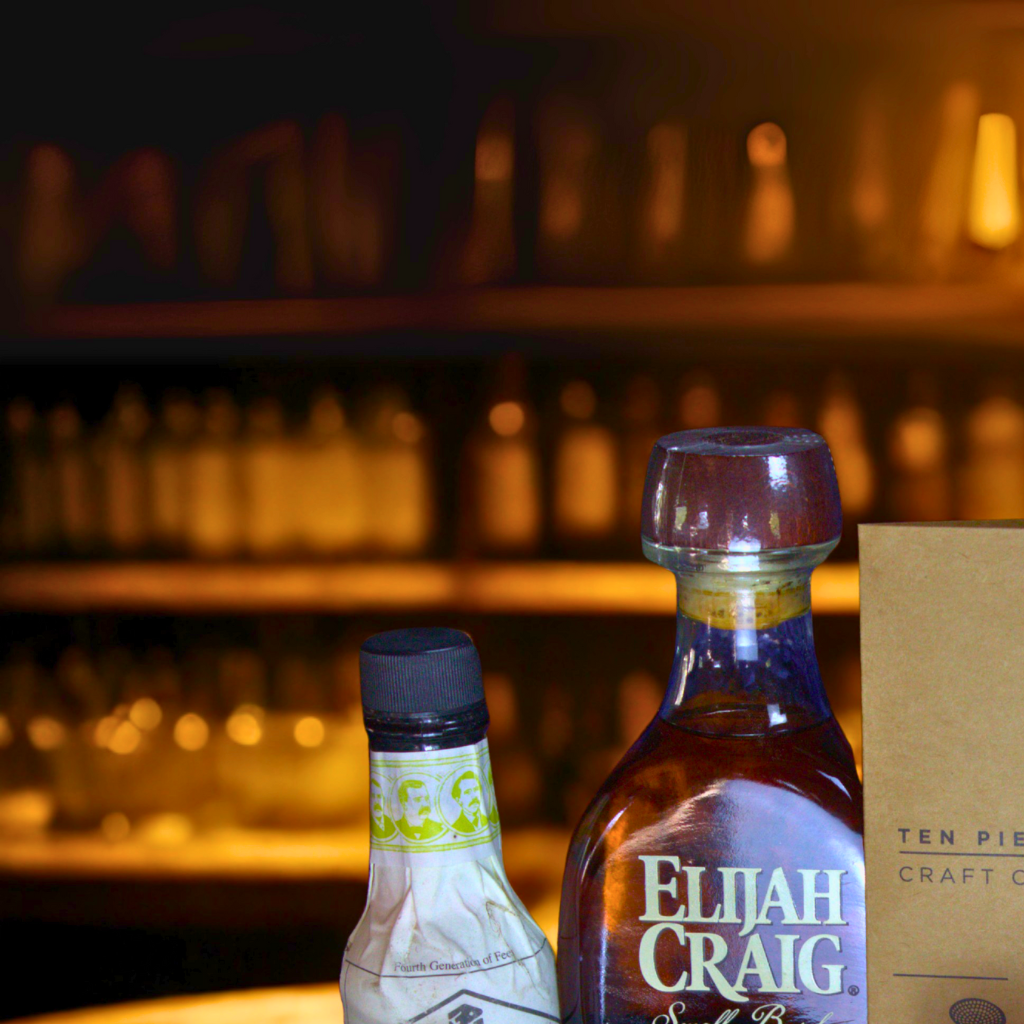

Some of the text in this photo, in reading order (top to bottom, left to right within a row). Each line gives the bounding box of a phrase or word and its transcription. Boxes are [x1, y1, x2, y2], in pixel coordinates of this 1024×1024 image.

[898, 828, 955, 846] TEN
[899, 866, 994, 885] CRAFT
[637, 854, 848, 937] ELIJAH
[393, 961, 427, 973] Fourth
[429, 958, 481, 971] Generation
[482, 955, 494, 965] of
[637, 922, 847, 1002] CRAIG
